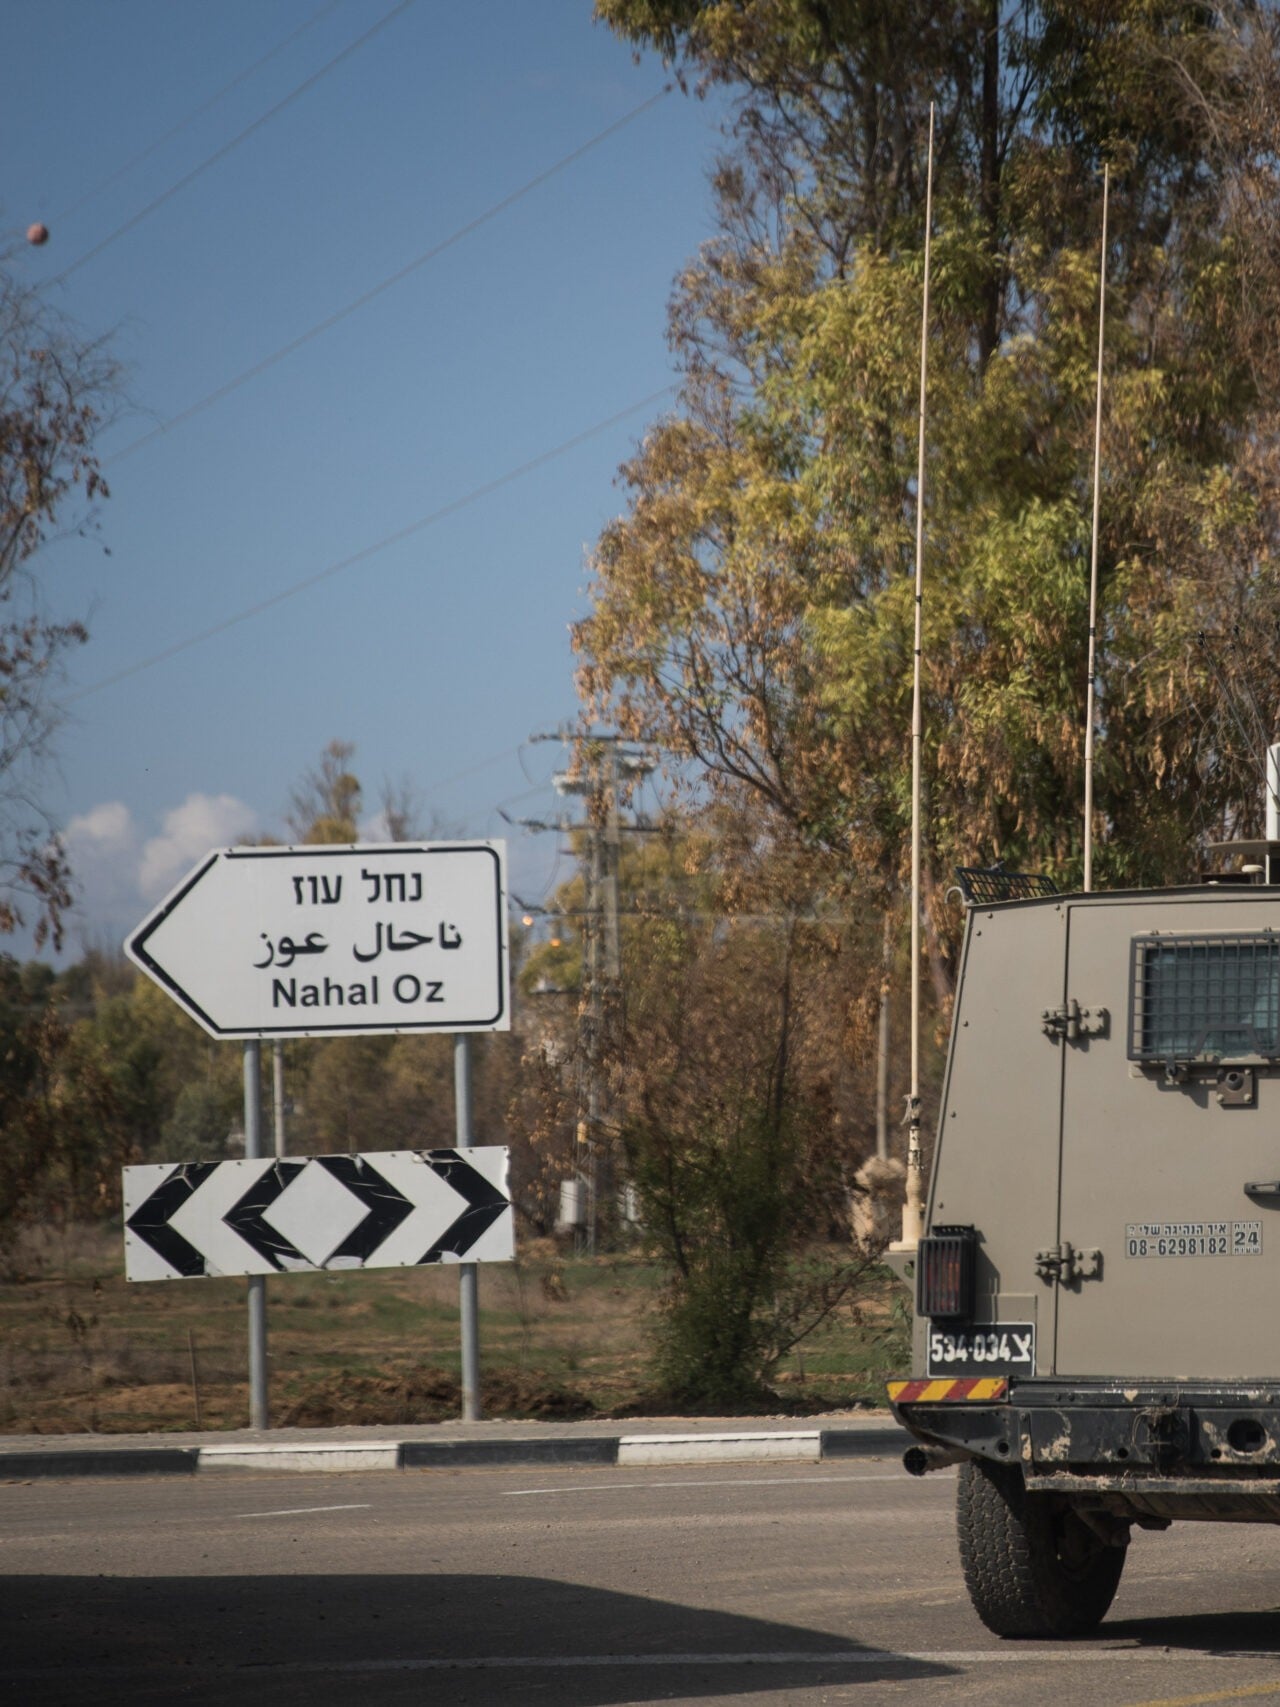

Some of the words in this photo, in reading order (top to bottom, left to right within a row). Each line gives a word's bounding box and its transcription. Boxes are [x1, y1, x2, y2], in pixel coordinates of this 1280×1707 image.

[292, 875, 342, 904] עוז
[360, 869, 423, 903] נחל
[253, 931, 329, 968] عوز
[352, 920, 462, 963] ناحال
[272, 975, 378, 1008] Nahal
[393, 974, 445, 1004] Oz
[1165, 1225, 1204, 1235] הנהיגה
[1234, 1231, 1259, 1246] 24
[1129, 1237, 1227, 1256] 08-6298182
